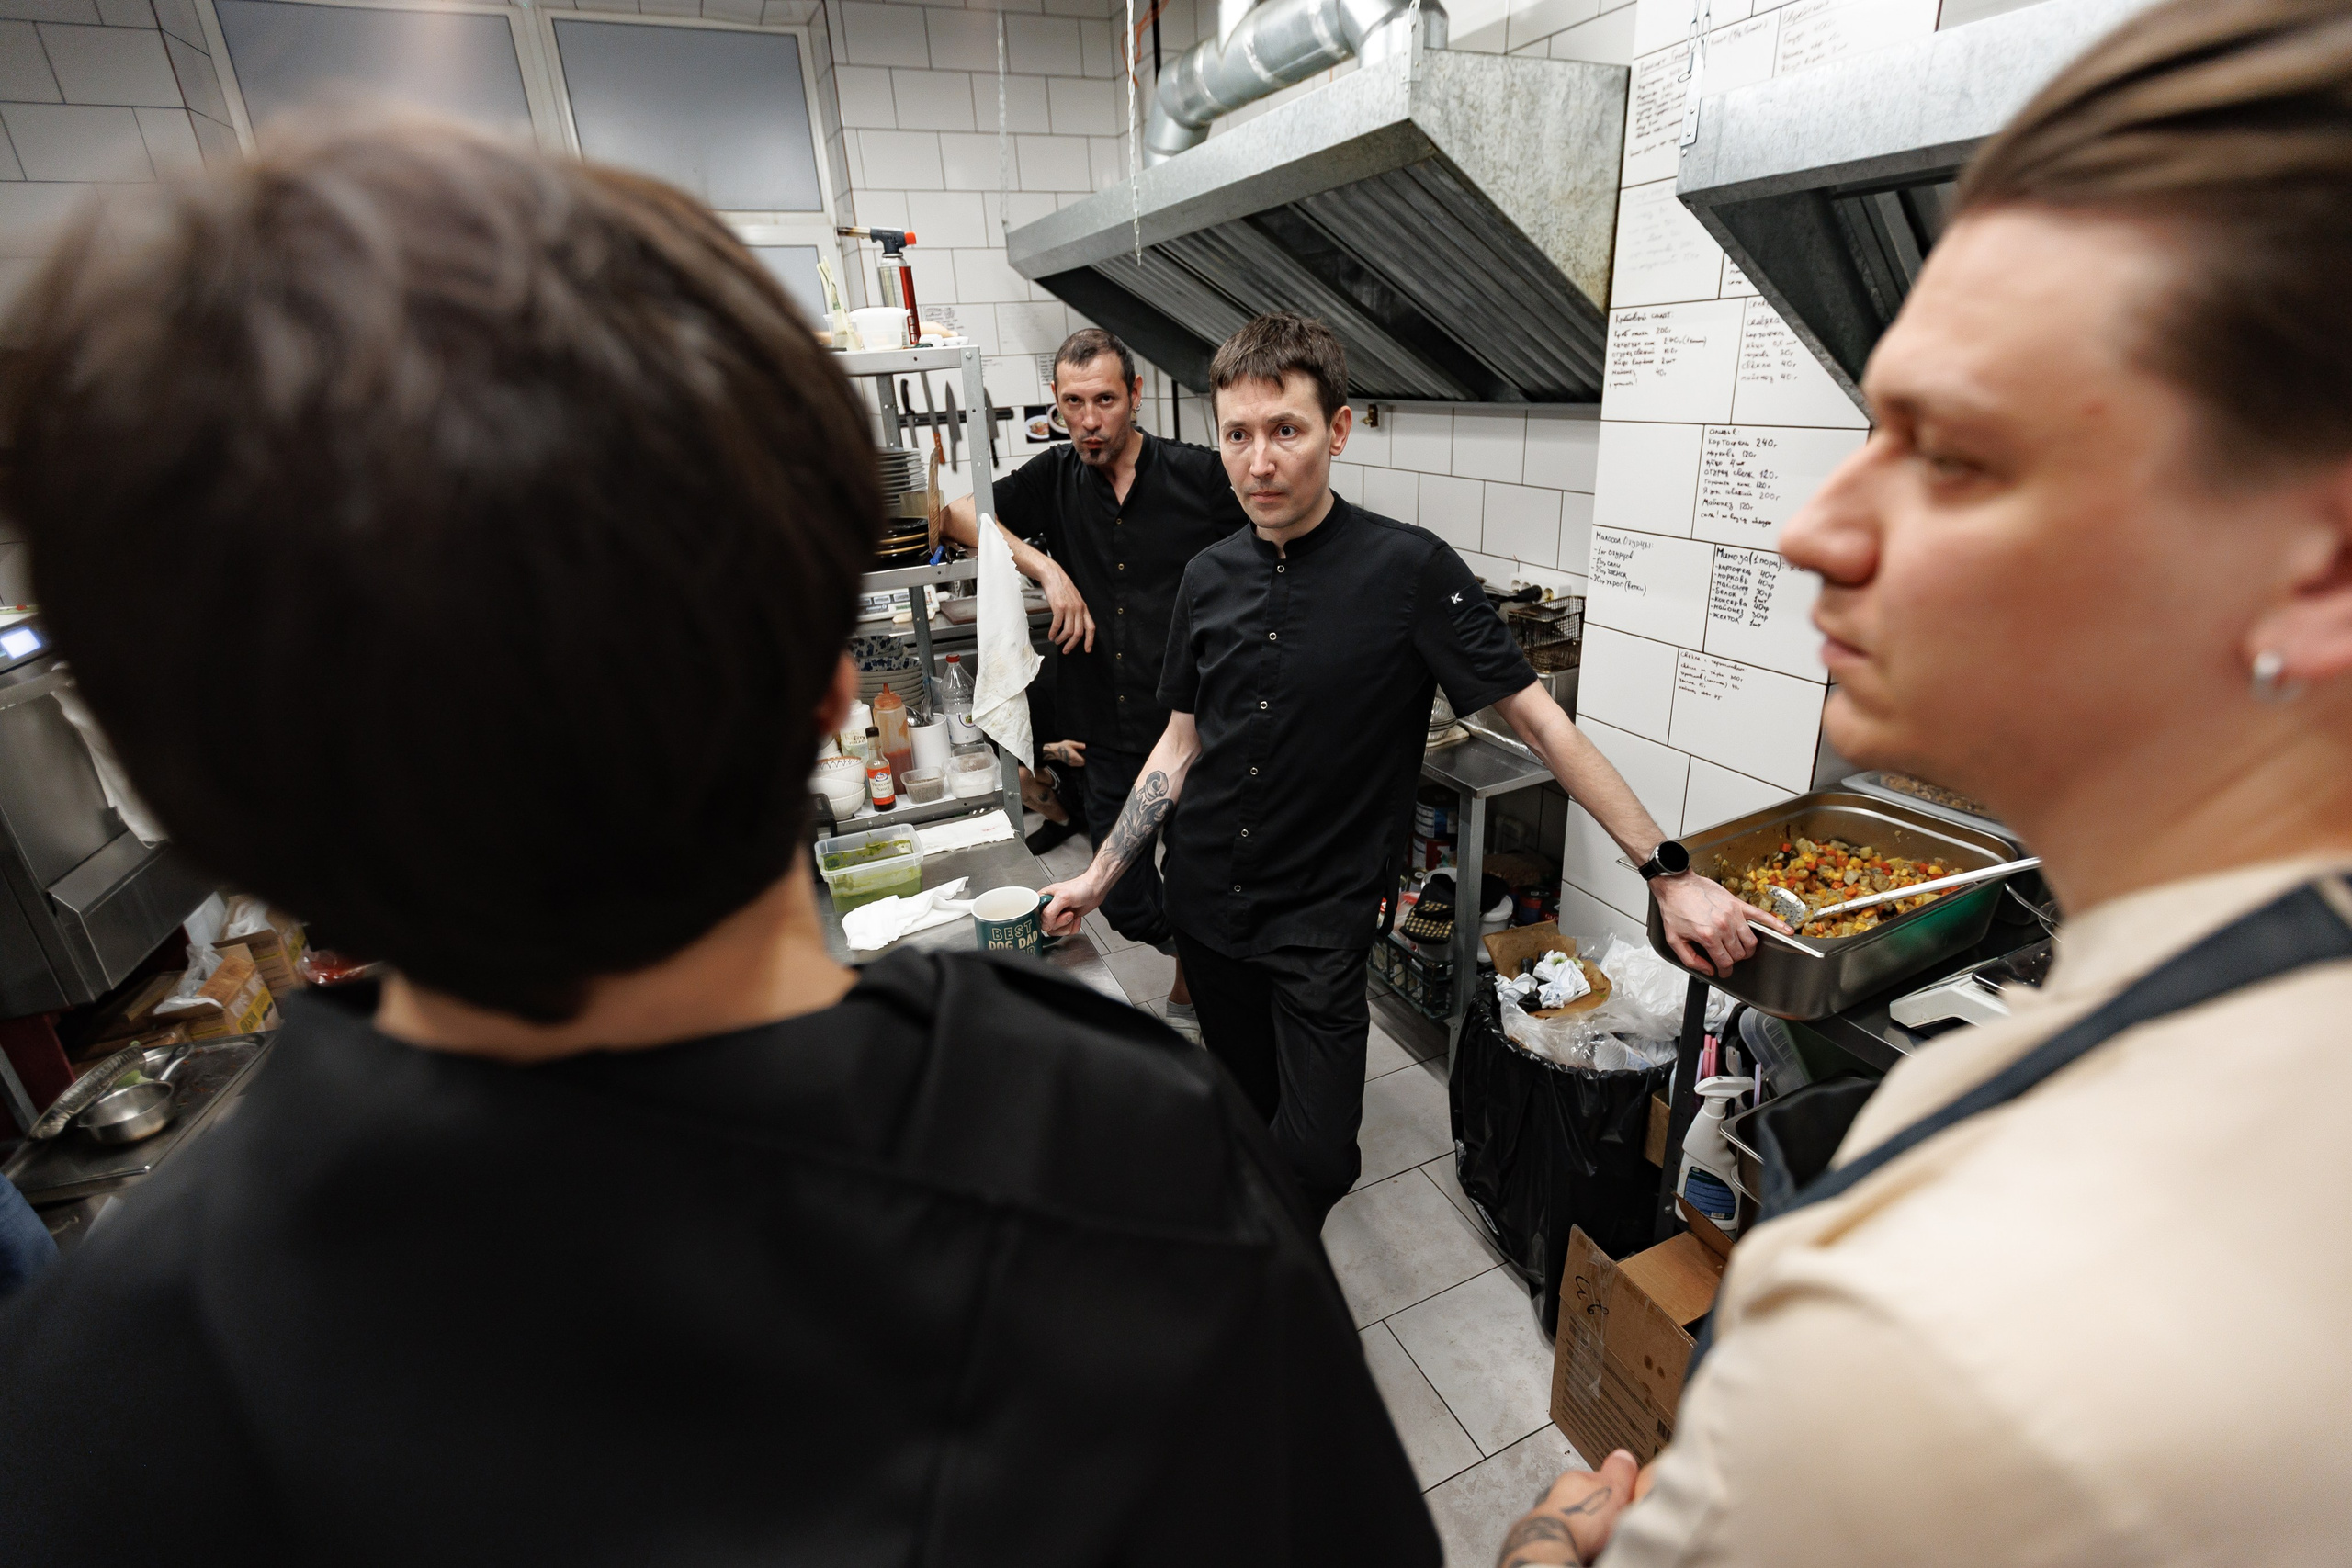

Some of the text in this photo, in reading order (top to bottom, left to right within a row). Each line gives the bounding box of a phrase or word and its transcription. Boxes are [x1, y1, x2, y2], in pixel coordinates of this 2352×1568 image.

[988, 940, 1014, 951] DOG
[1018, 930, 1038, 950] DAD
[991, 919, 1033, 941] BEST
